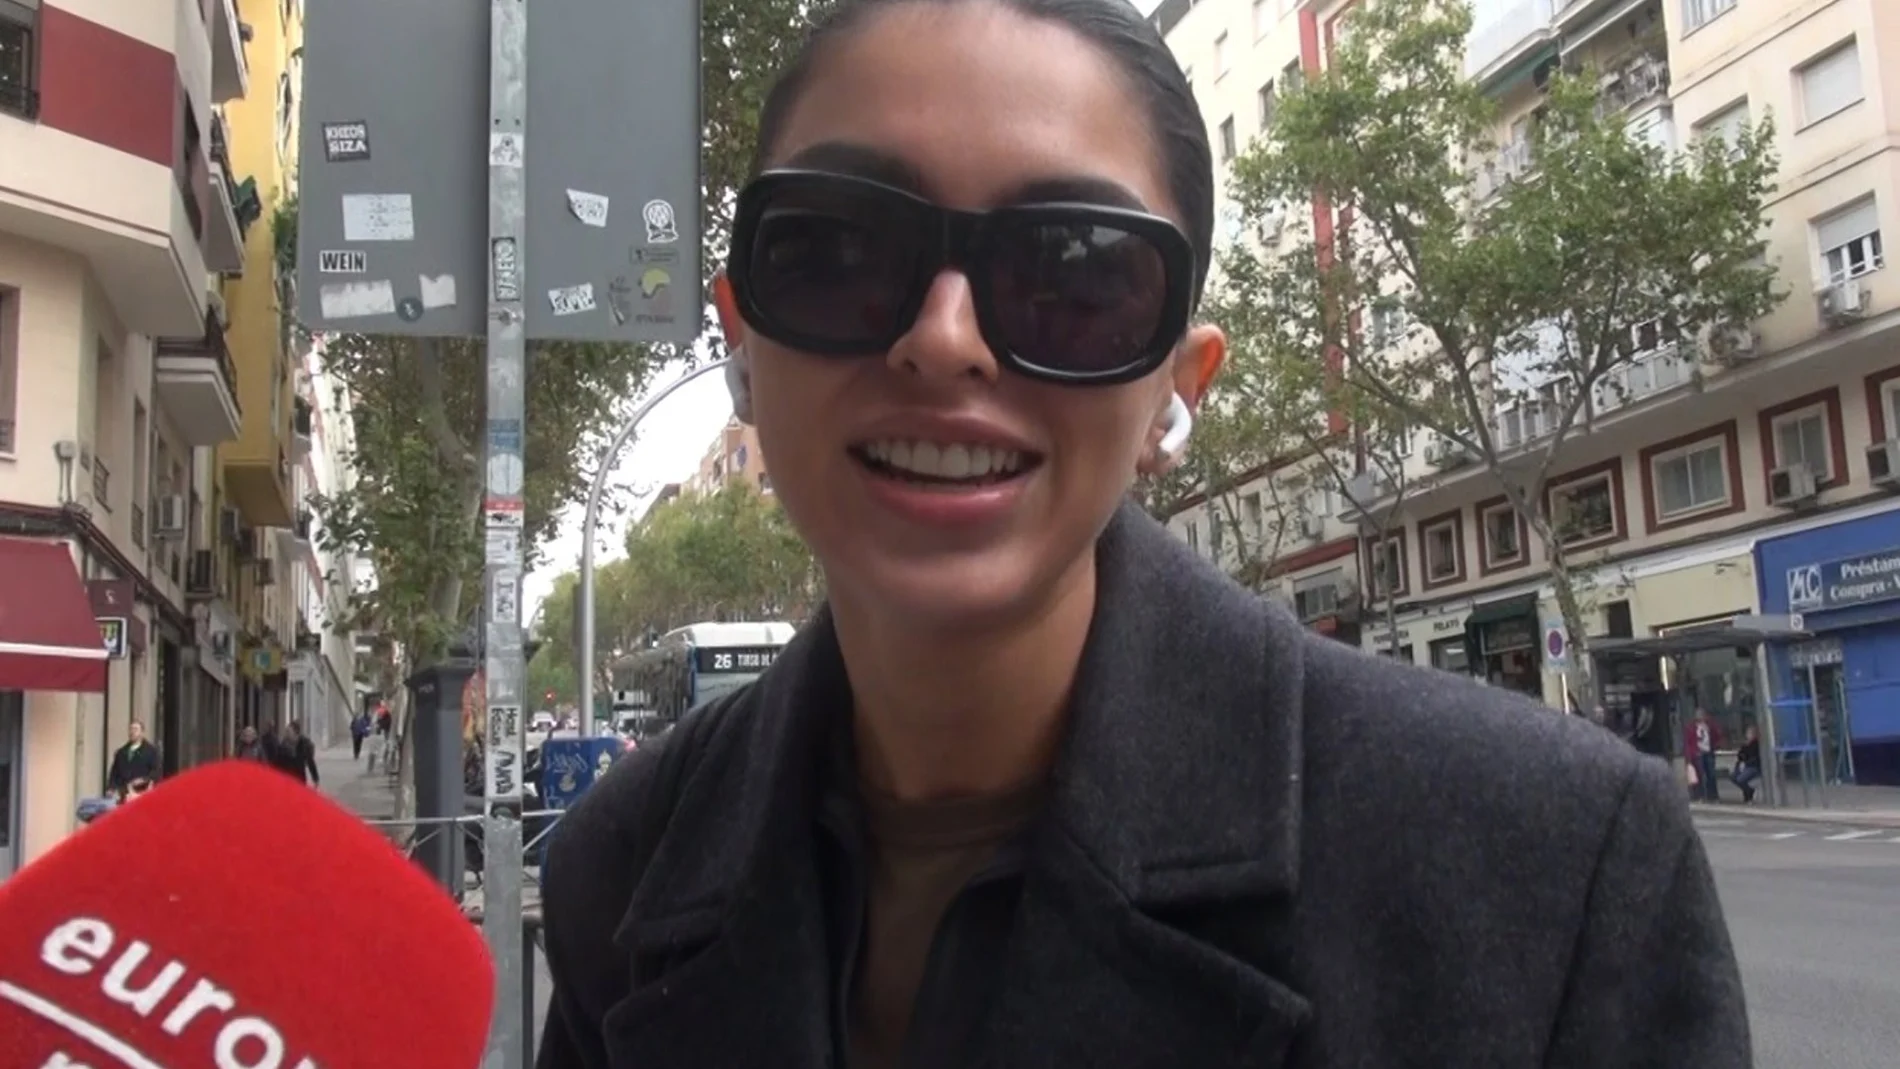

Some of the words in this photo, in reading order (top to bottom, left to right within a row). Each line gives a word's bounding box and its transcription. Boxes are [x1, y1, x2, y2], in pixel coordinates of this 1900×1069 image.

[322, 253, 364, 270] WEIN
[1830, 581, 1885, 601] Compra
[714, 654, 732, 669] 26
[41, 917, 316, 1069] euro
